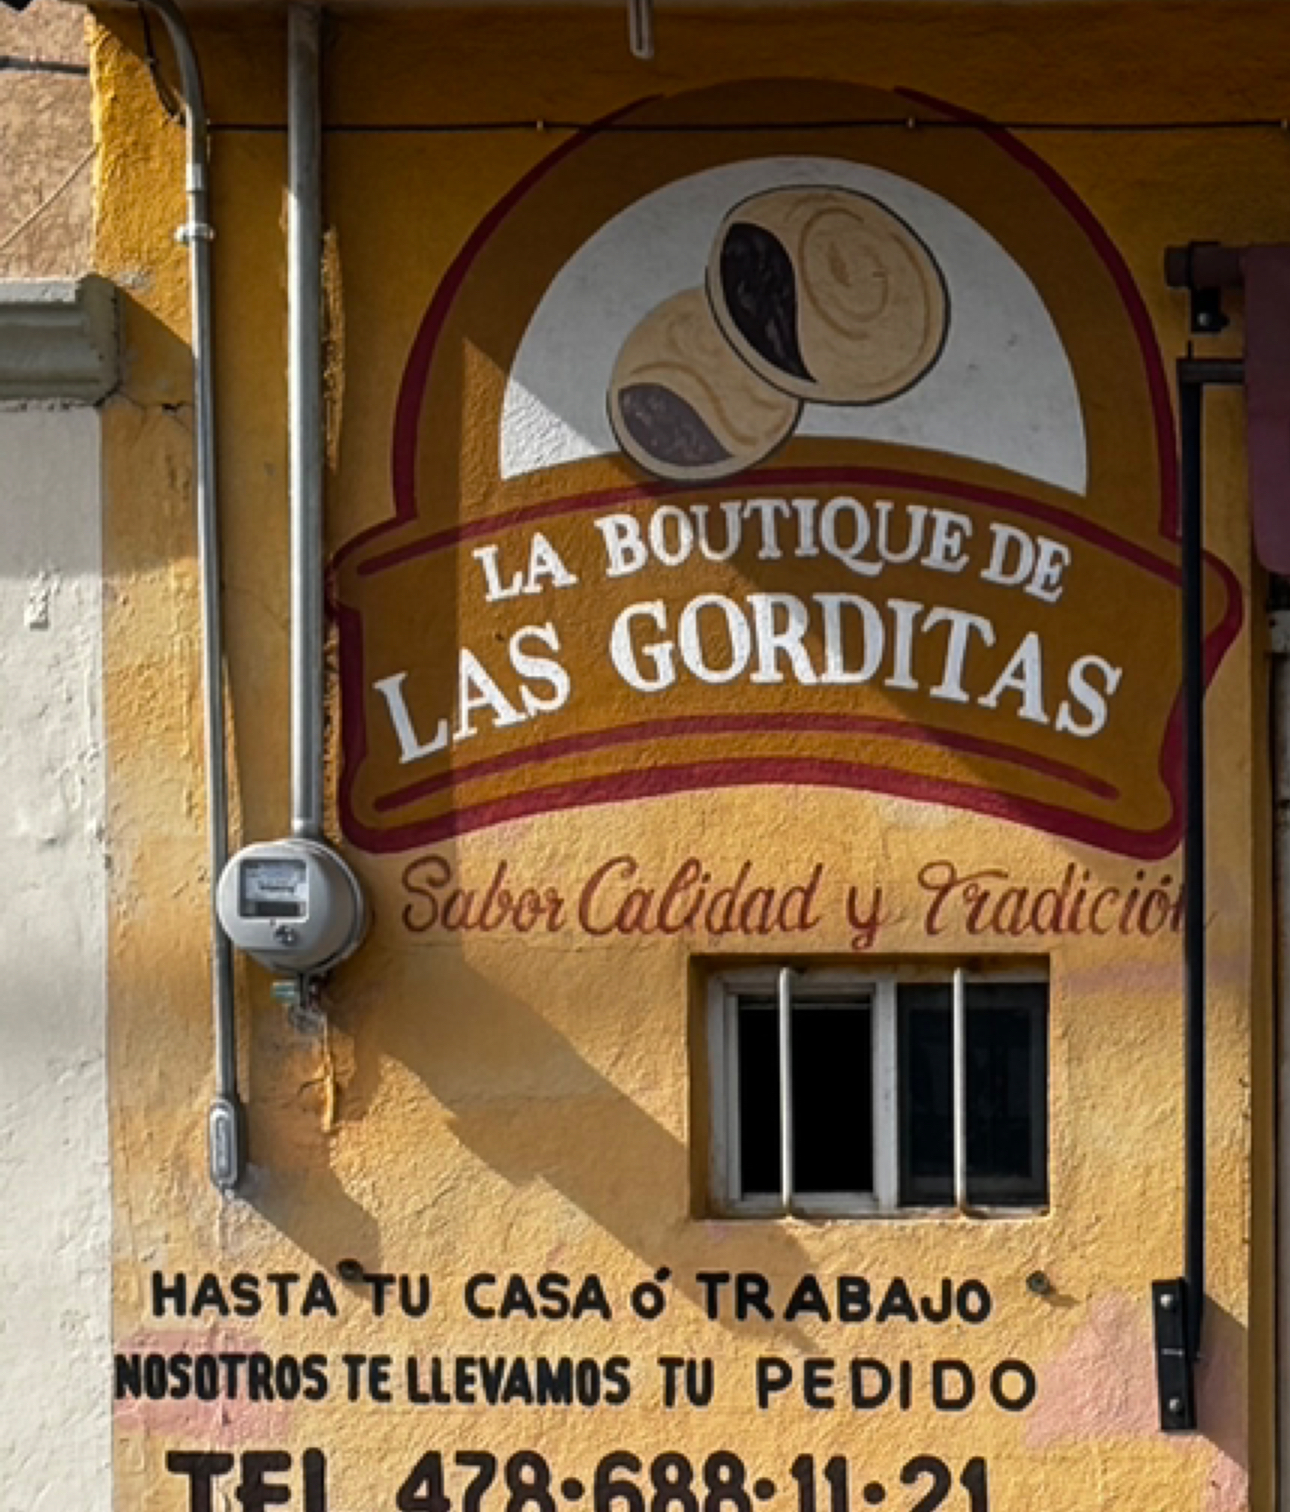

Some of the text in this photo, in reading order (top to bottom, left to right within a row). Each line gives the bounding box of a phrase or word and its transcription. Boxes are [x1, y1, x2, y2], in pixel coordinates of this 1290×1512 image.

[472, 494, 1074, 605] LA BOUTIQUE DE
[374, 592, 1124, 765] LAS GORDITAS
[401, 855, 567, 937] Sabor
[579, 855, 823, 935] Calidad
[844, 885, 884, 949] y
[151, 1271, 337, 1321] HASTA
[364, 1273, 429, 1320] TU
[464, 1273, 611, 1320] CASA
[694, 1273, 993, 1325] TRABAJO
[114, 1354, 1037, 1411] NOSOTROS TE LLEVAMOS TU PEDIDO
